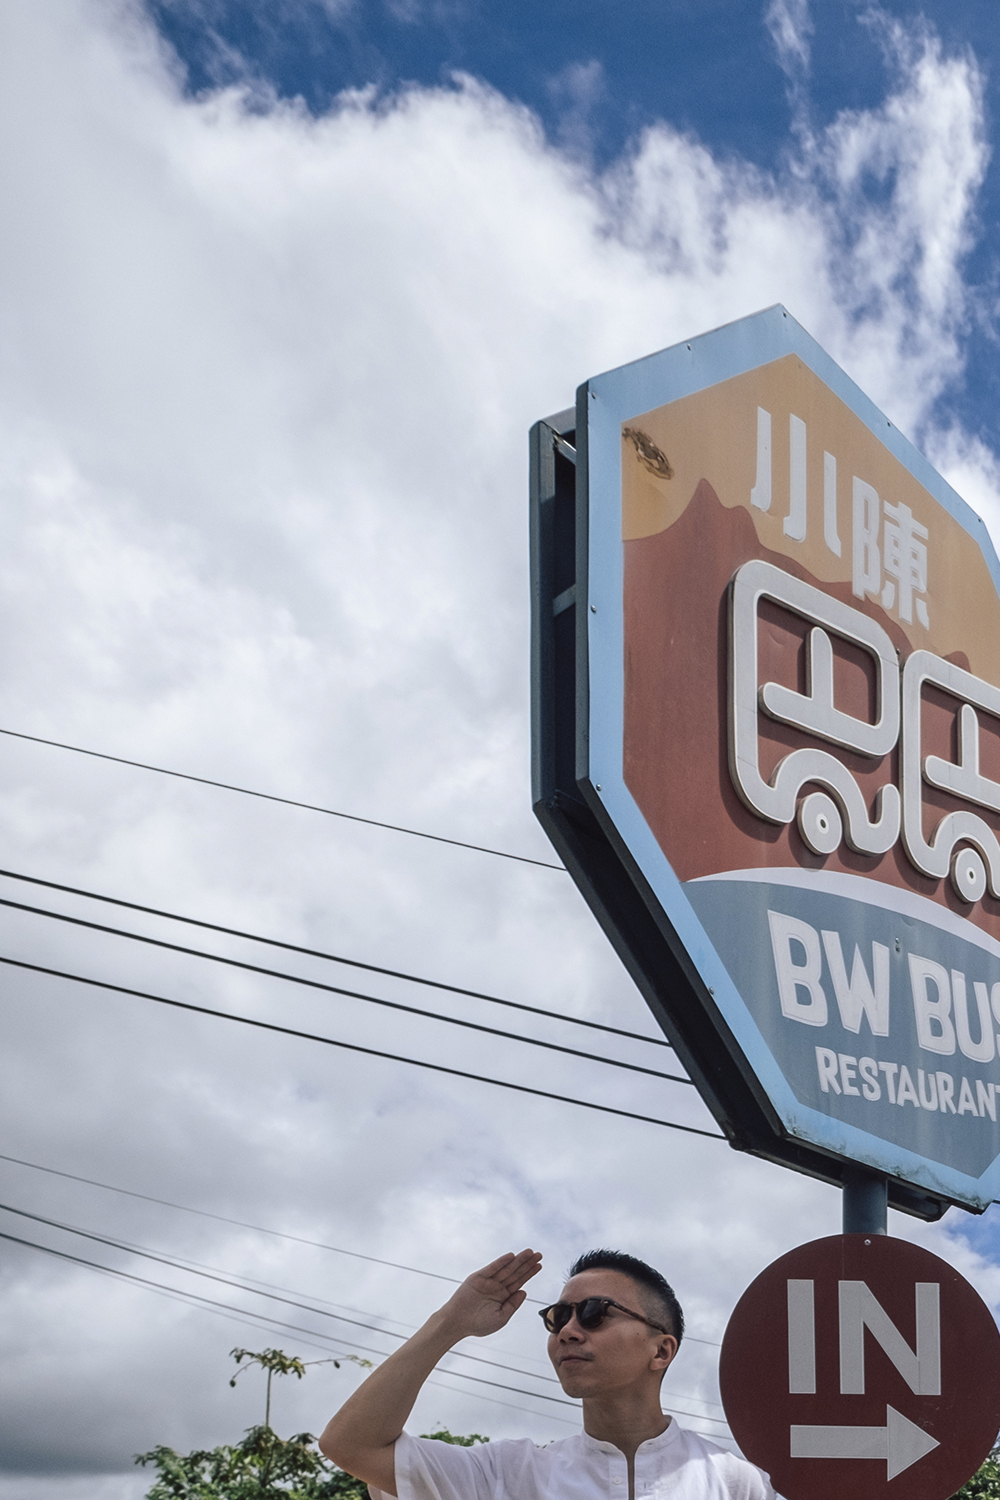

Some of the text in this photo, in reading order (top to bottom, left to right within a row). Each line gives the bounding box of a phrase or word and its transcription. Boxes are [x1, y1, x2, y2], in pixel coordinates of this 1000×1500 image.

[751, 406, 929, 631] 小陳
[767, 909, 890, 1037] BW
[787, 1279, 941, 1396] IN
